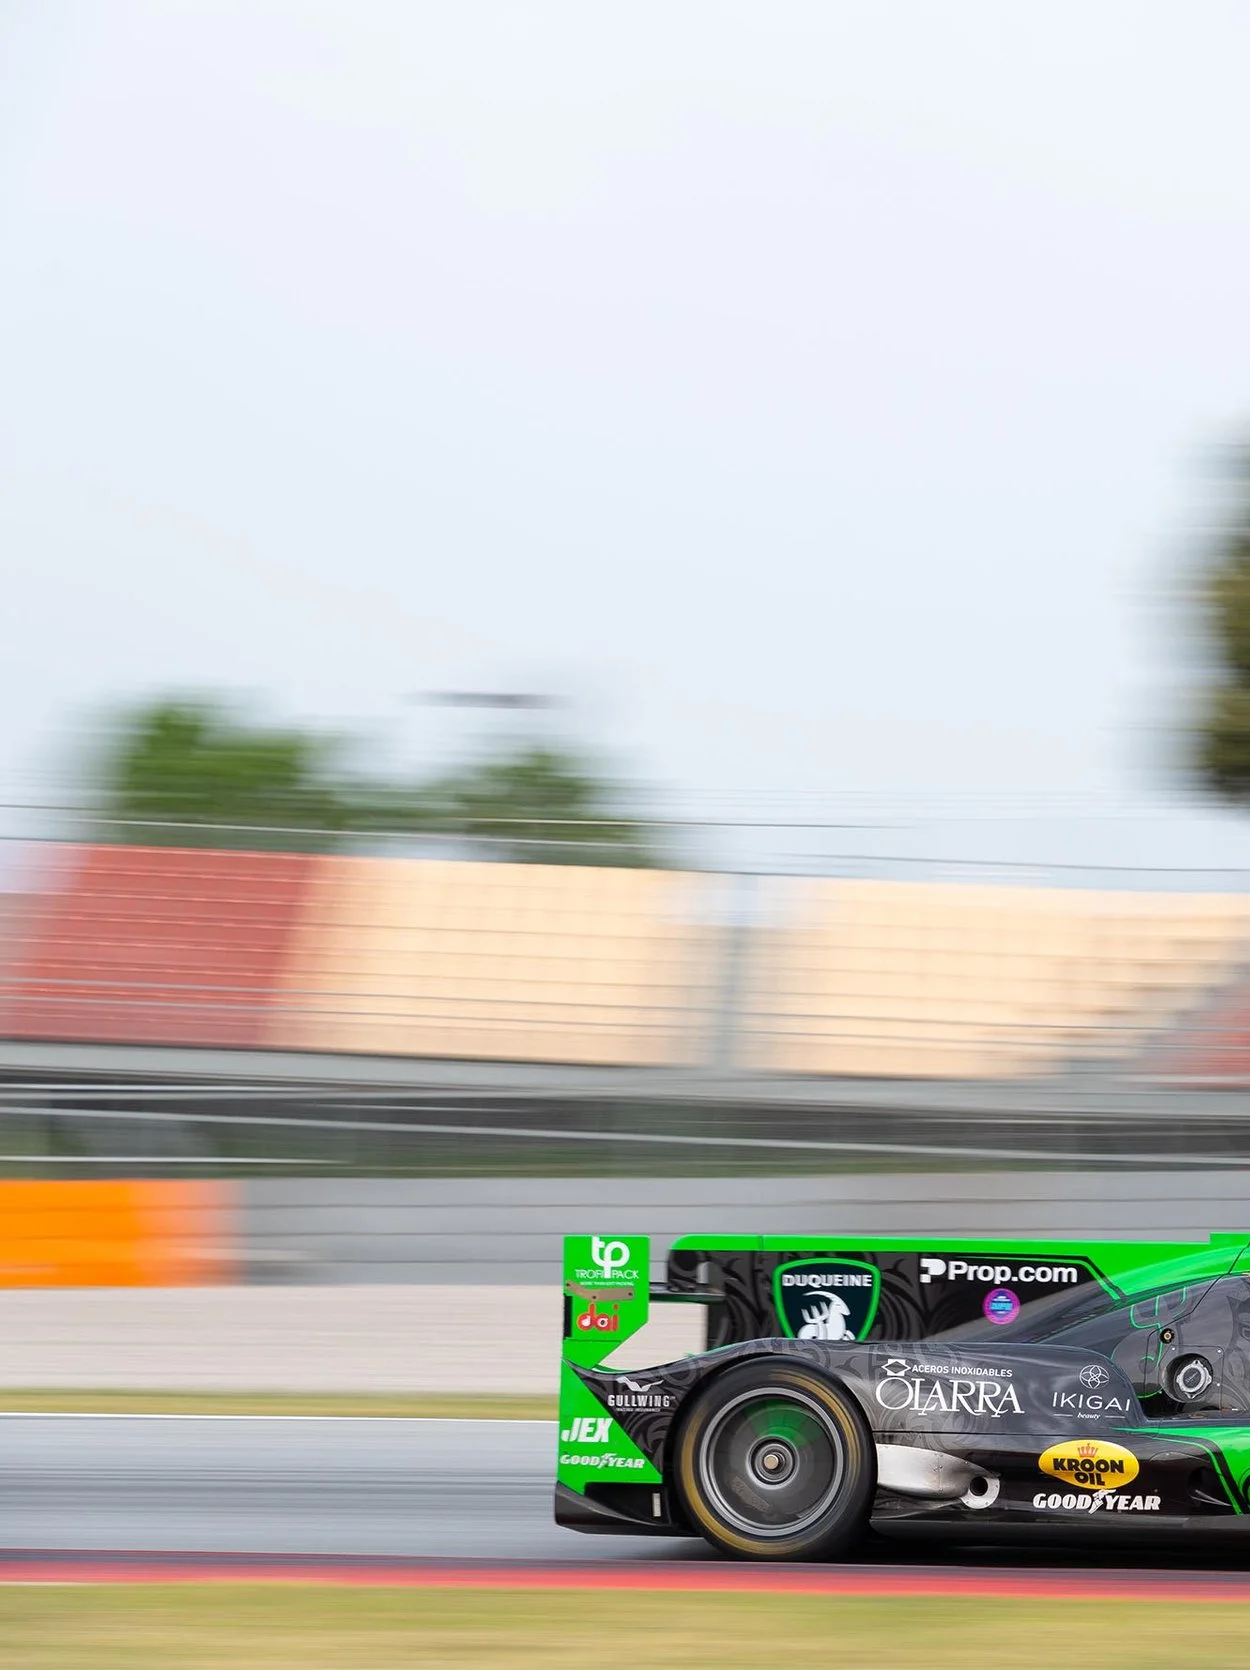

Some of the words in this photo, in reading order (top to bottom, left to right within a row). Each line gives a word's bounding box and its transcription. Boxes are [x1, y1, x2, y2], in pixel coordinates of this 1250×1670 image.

[612, 1269, 639, 1280] PACK
[782, 1274, 872, 1288] DUQUEINE
[948, 1261, 1078, 1285] Prop.com
[911, 1364, 949, 1375] ACEROS
[951, 1366, 1013, 1378] INOXIDABLES
[608, 1395, 670, 1407] GULLWING
[875, 1376, 1025, 1418] OLARRA
[1052, 1391, 1131, 1412] IKIGAI
[561, 1417, 613, 1442] JEX
[560, 1453, 645, 1469] GOODYEAR
[1053, 1458, 1125, 1474] KROON
[1074, 1471, 1106, 1487] OIL
[1032, 1489, 1162, 1514] GOODYEAR
